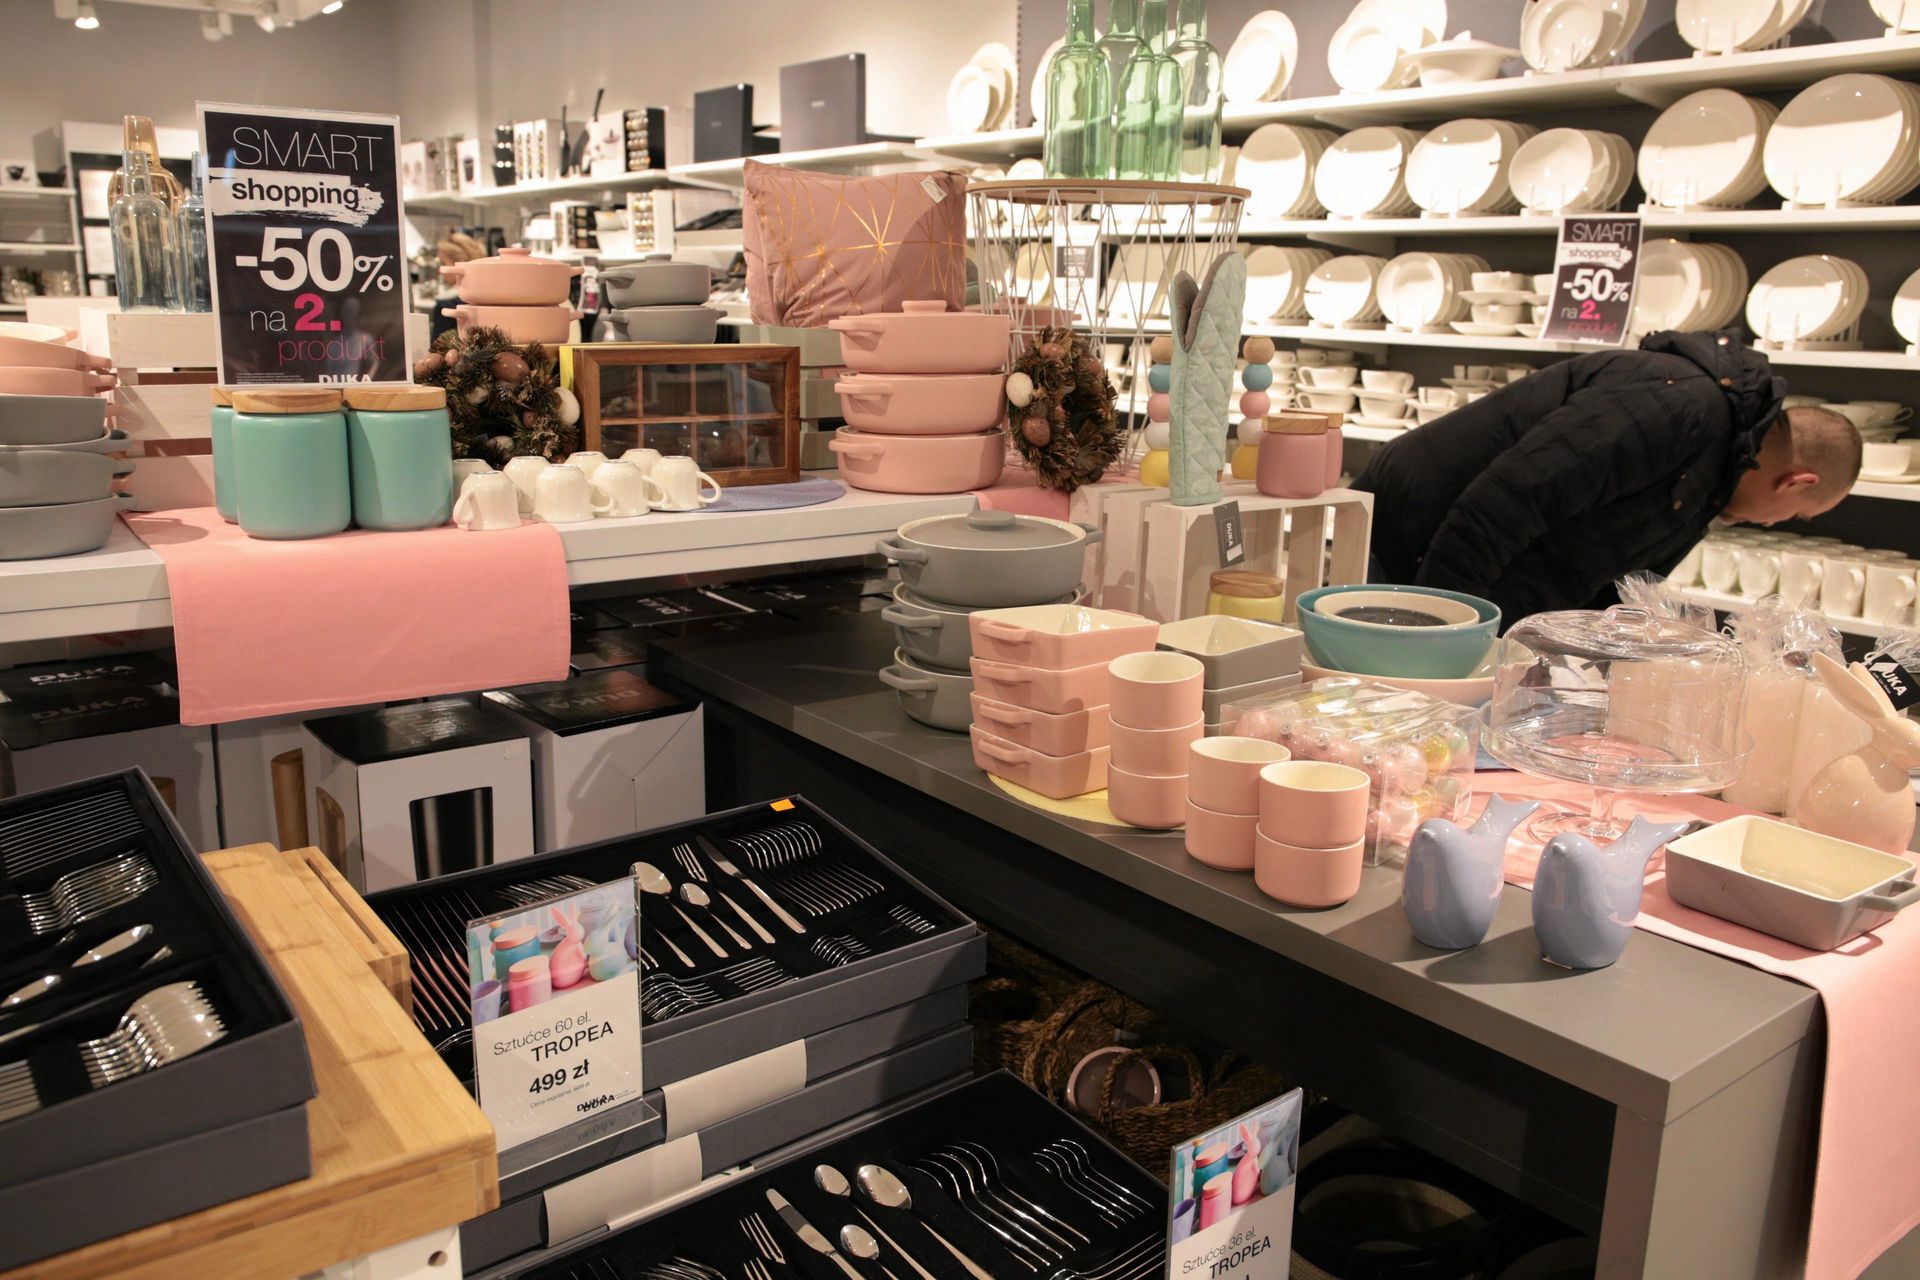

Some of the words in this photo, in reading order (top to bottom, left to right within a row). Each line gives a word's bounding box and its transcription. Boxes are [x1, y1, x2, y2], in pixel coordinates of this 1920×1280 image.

[232, 126, 383, 172] SMART
[232, 178, 359, 211] shopping
[1571, 222, 1637, 242] SMART
[1568, 247, 1622, 262] shopping
[250, 309, 288, 332] na
[294, 293, 342, 332] 2.
[1561, 306, 1578, 319] na
[1579, 299, 1601, 320] 2.
[278, 335, 387, 367] produkt
[1226, 522, 1234, 547] DUKA
[29, 665, 136, 683] DUKA
[1880, 671, 1908, 697] UKA
[494, 1027, 551, 1056] Sztućce
[555, 1017, 573, 1034] 60
[577, 1011, 592, 1026] el.
[530, 1021, 614, 1062] TROPEA
[529, 1068, 567, 1094] 499
[573, 1059, 590, 1080] zł
[1183, 1244, 1226, 1274] Sztućce
[1229, 1233, 1243, 1250] 36
[1245, 1226, 1257, 1241] el.
[1209, 1236, 1271, 1279] TROPEA
